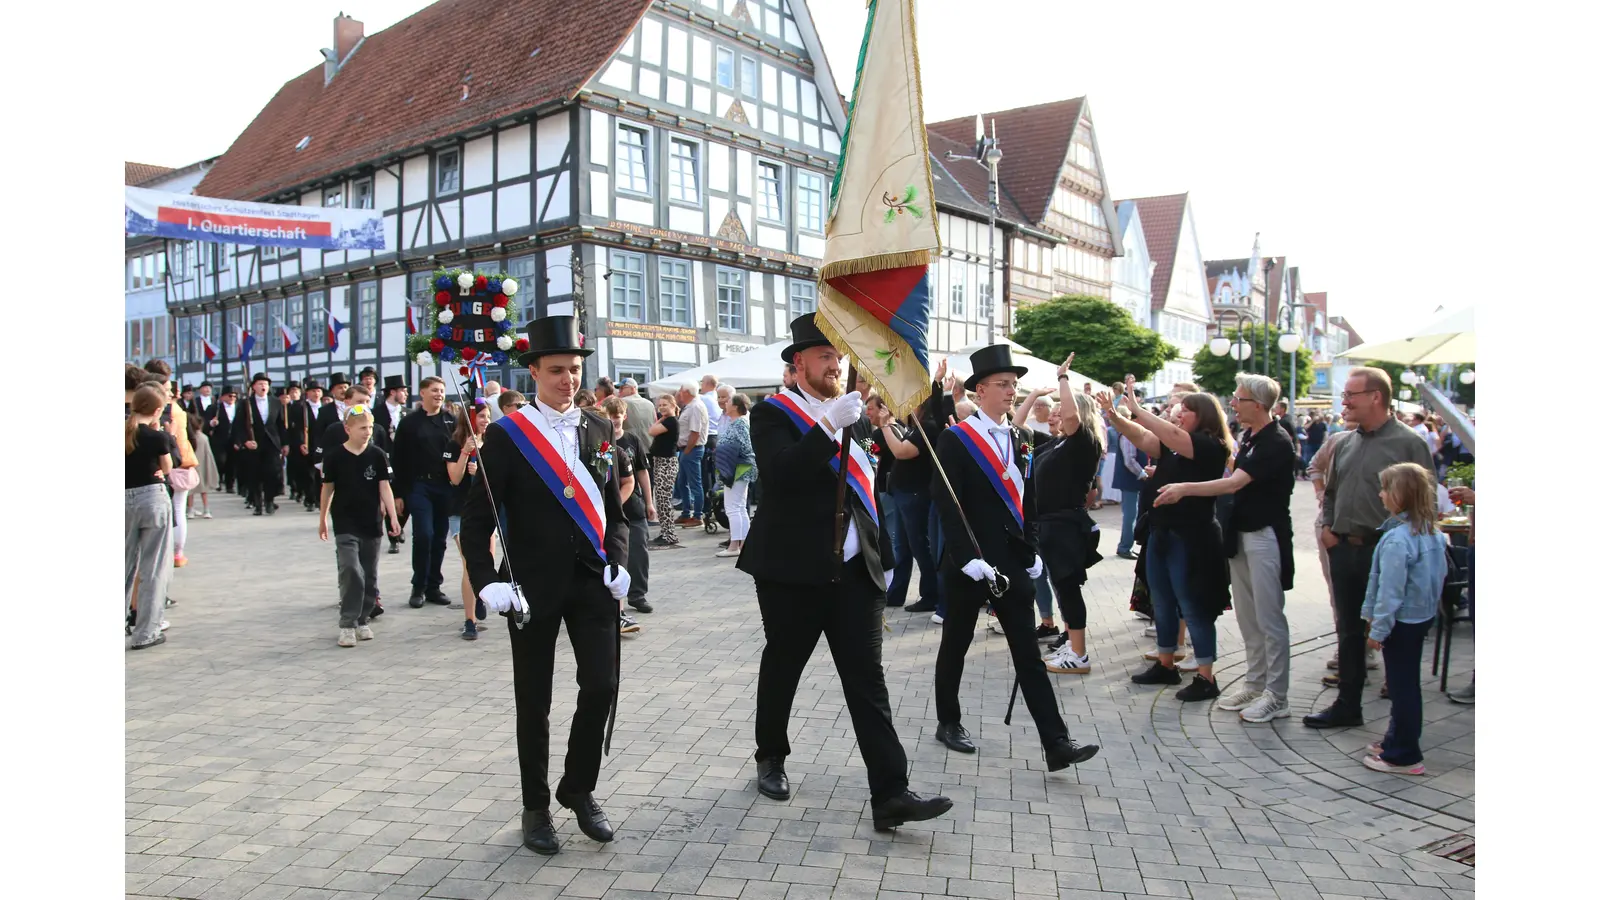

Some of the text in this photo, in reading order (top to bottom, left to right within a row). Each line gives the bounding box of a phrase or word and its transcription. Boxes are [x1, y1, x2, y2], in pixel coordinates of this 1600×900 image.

[187, 217, 306, 240] I. Quartierschaft
[610, 221, 642, 233] DOMINE
[649, 228, 688, 240] CONSERVA
[452, 323, 495, 342] ÜRGE
[726, 344, 759, 353] MERCAD
